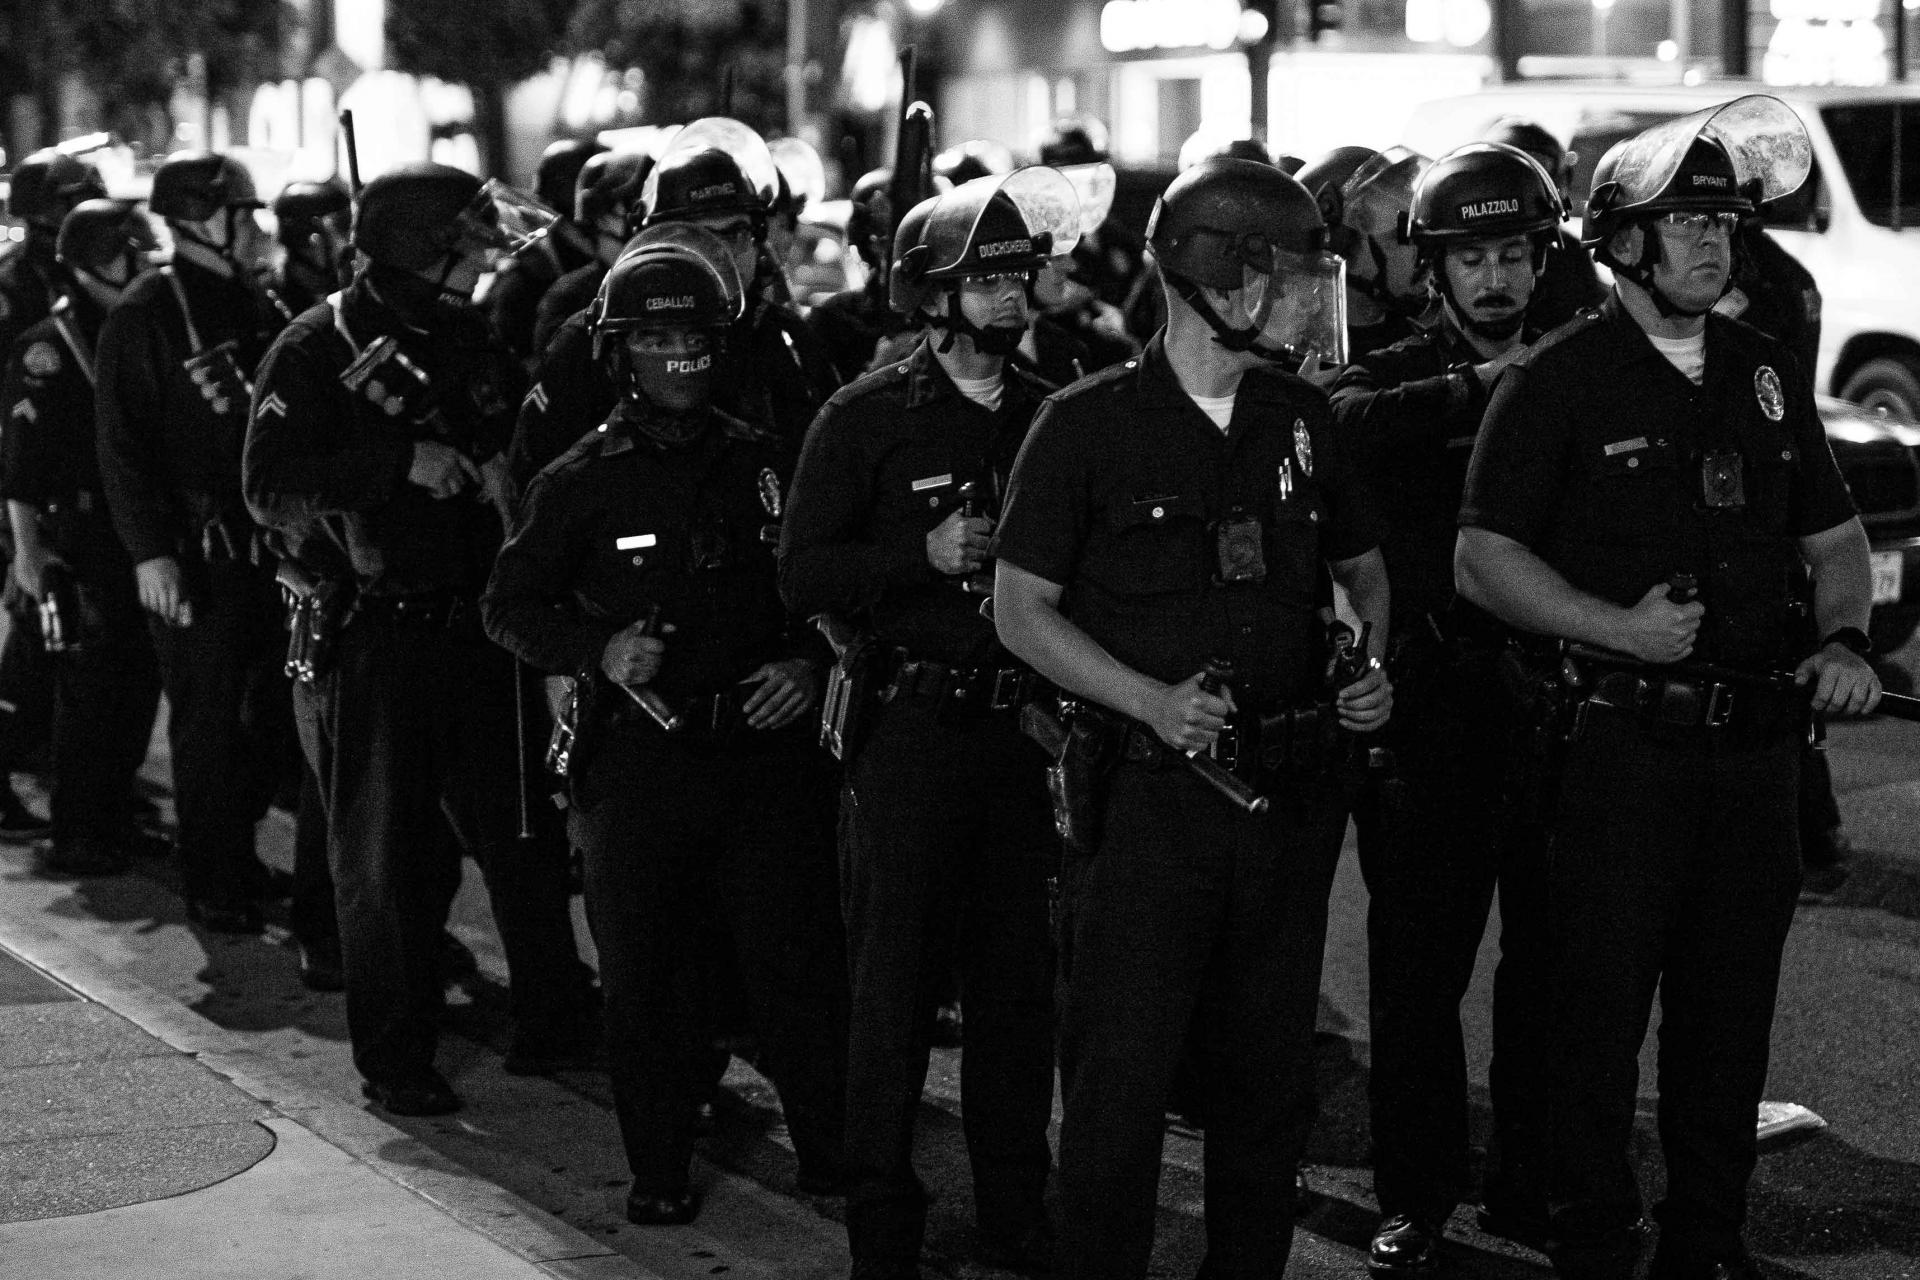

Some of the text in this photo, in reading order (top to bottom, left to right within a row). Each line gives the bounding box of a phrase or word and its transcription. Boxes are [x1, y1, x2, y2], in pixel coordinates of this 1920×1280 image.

[1692, 175, 1728, 187] BRYANT
[1461, 199, 1518, 219] PALAZZOLO
[646, 295, 695, 310] CEBALLOS
